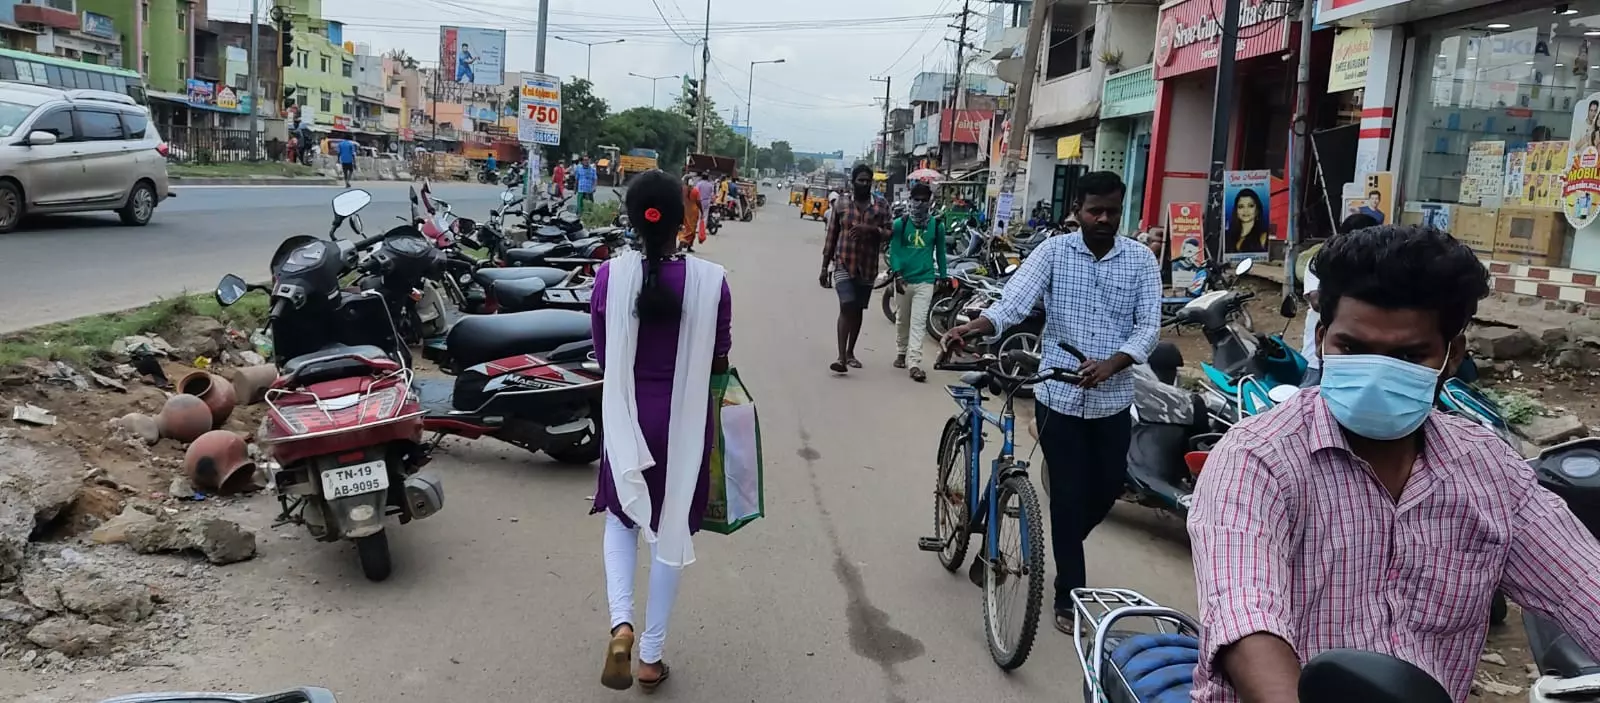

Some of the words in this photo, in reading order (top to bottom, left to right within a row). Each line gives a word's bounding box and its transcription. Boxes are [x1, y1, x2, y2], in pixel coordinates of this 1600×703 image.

[1173, 23, 1195, 48] Sree
[1195, 14, 1224, 44] Gup
[1200, 47, 1219, 61] Sweets
[527, 104, 558, 124] 750
[958, 119, 981, 130] airte
[506, 373, 561, 390] MAEST
[336, 465, 372, 481] TN-19
[334, 479, 380, 497] AB-9095
